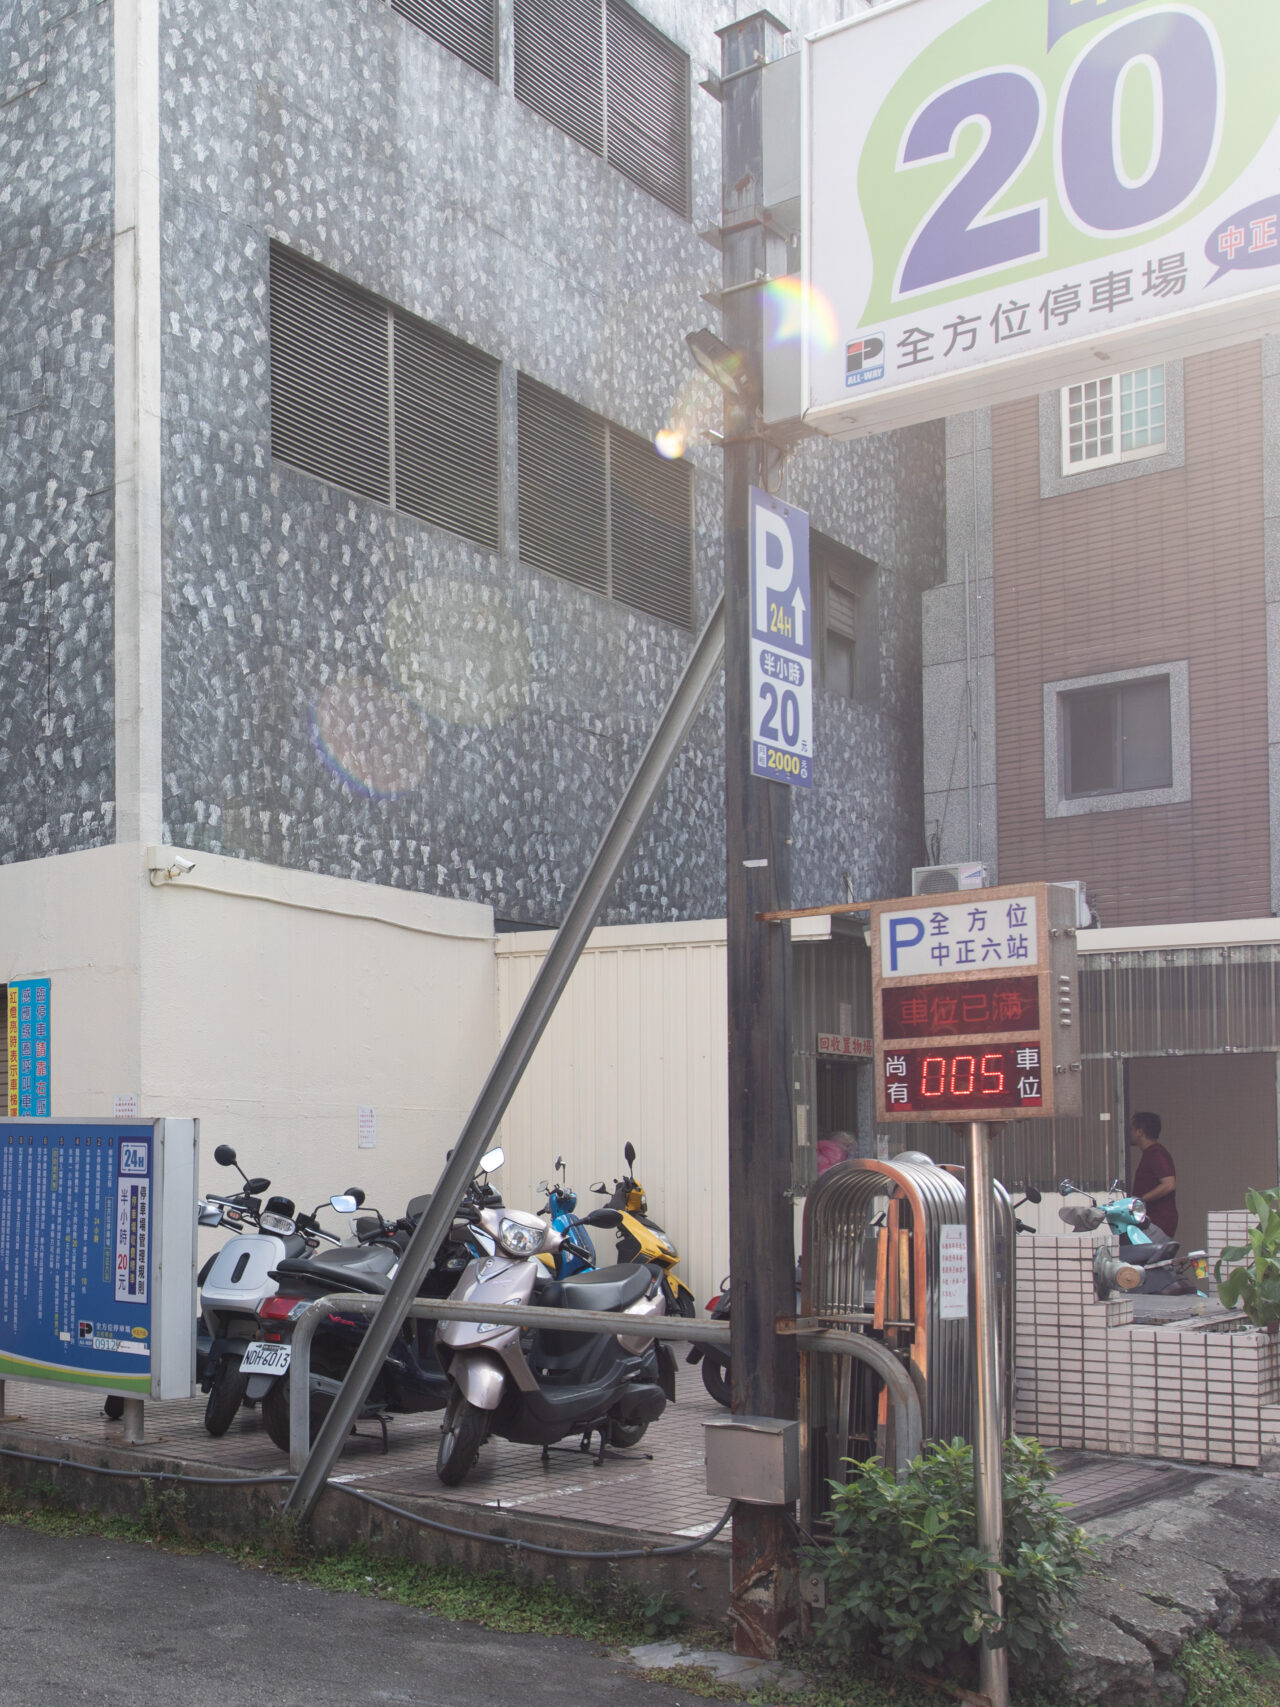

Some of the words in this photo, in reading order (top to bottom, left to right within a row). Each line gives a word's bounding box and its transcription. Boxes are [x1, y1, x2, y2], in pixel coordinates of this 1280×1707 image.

[897, 8, 1220, 296] 20
[1219, 215, 1278, 261] 中正
[896, 252, 1188, 370] 全方位停車場
[847, 367, 882, 386] ALL-WAY
[755, 504, 794, 633] P
[770, 602, 792, 638] 24H
[762, 652, 801, 685] 半小時
[759, 681, 800, 747] 20
[767, 748, 800, 775] 2000
[929, 903, 1028, 937] 全方位
[889, 917, 925, 972] P
[930, 933, 1029, 967] 中正六站
[900, 991, 1023, 1028] 車位已滿
[819, 1036, 872, 1056] 回收置物場
[885, 1055, 909, 1104] 尚有
[921, 1054, 1005, 1097] 005
[1016, 1047, 1041, 1100] 車位
[124, 1149, 145, 1169] 24H
